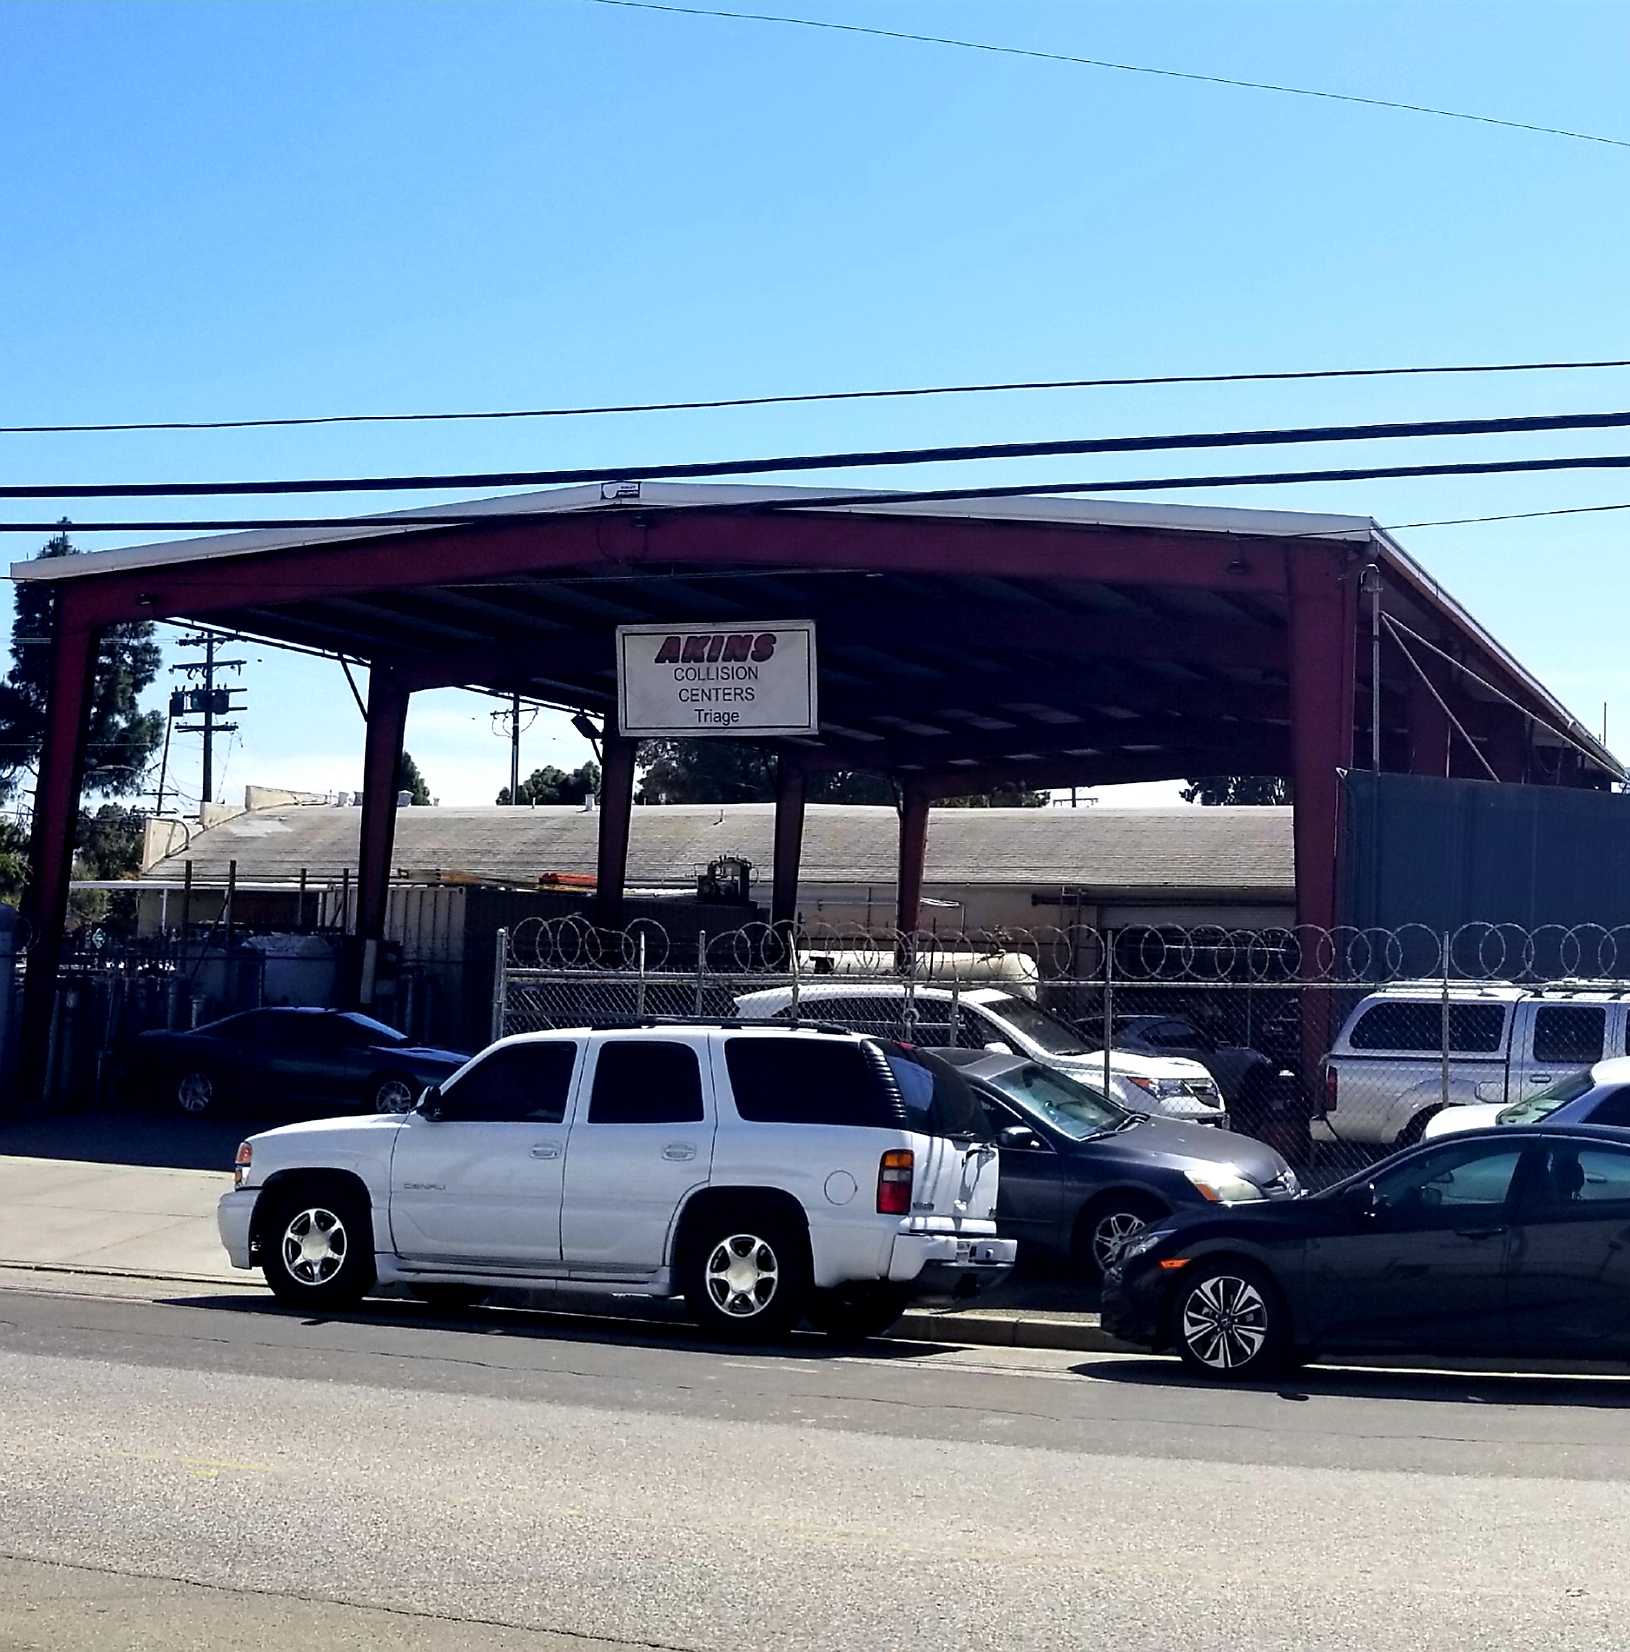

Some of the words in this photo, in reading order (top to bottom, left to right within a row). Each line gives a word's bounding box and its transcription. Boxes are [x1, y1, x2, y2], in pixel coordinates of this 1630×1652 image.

[655, 634, 777, 663] AKINS
[673, 666, 759, 682] COLLISION
[678, 687, 756, 703] CENTERS
[694, 708, 740, 726] Triage
